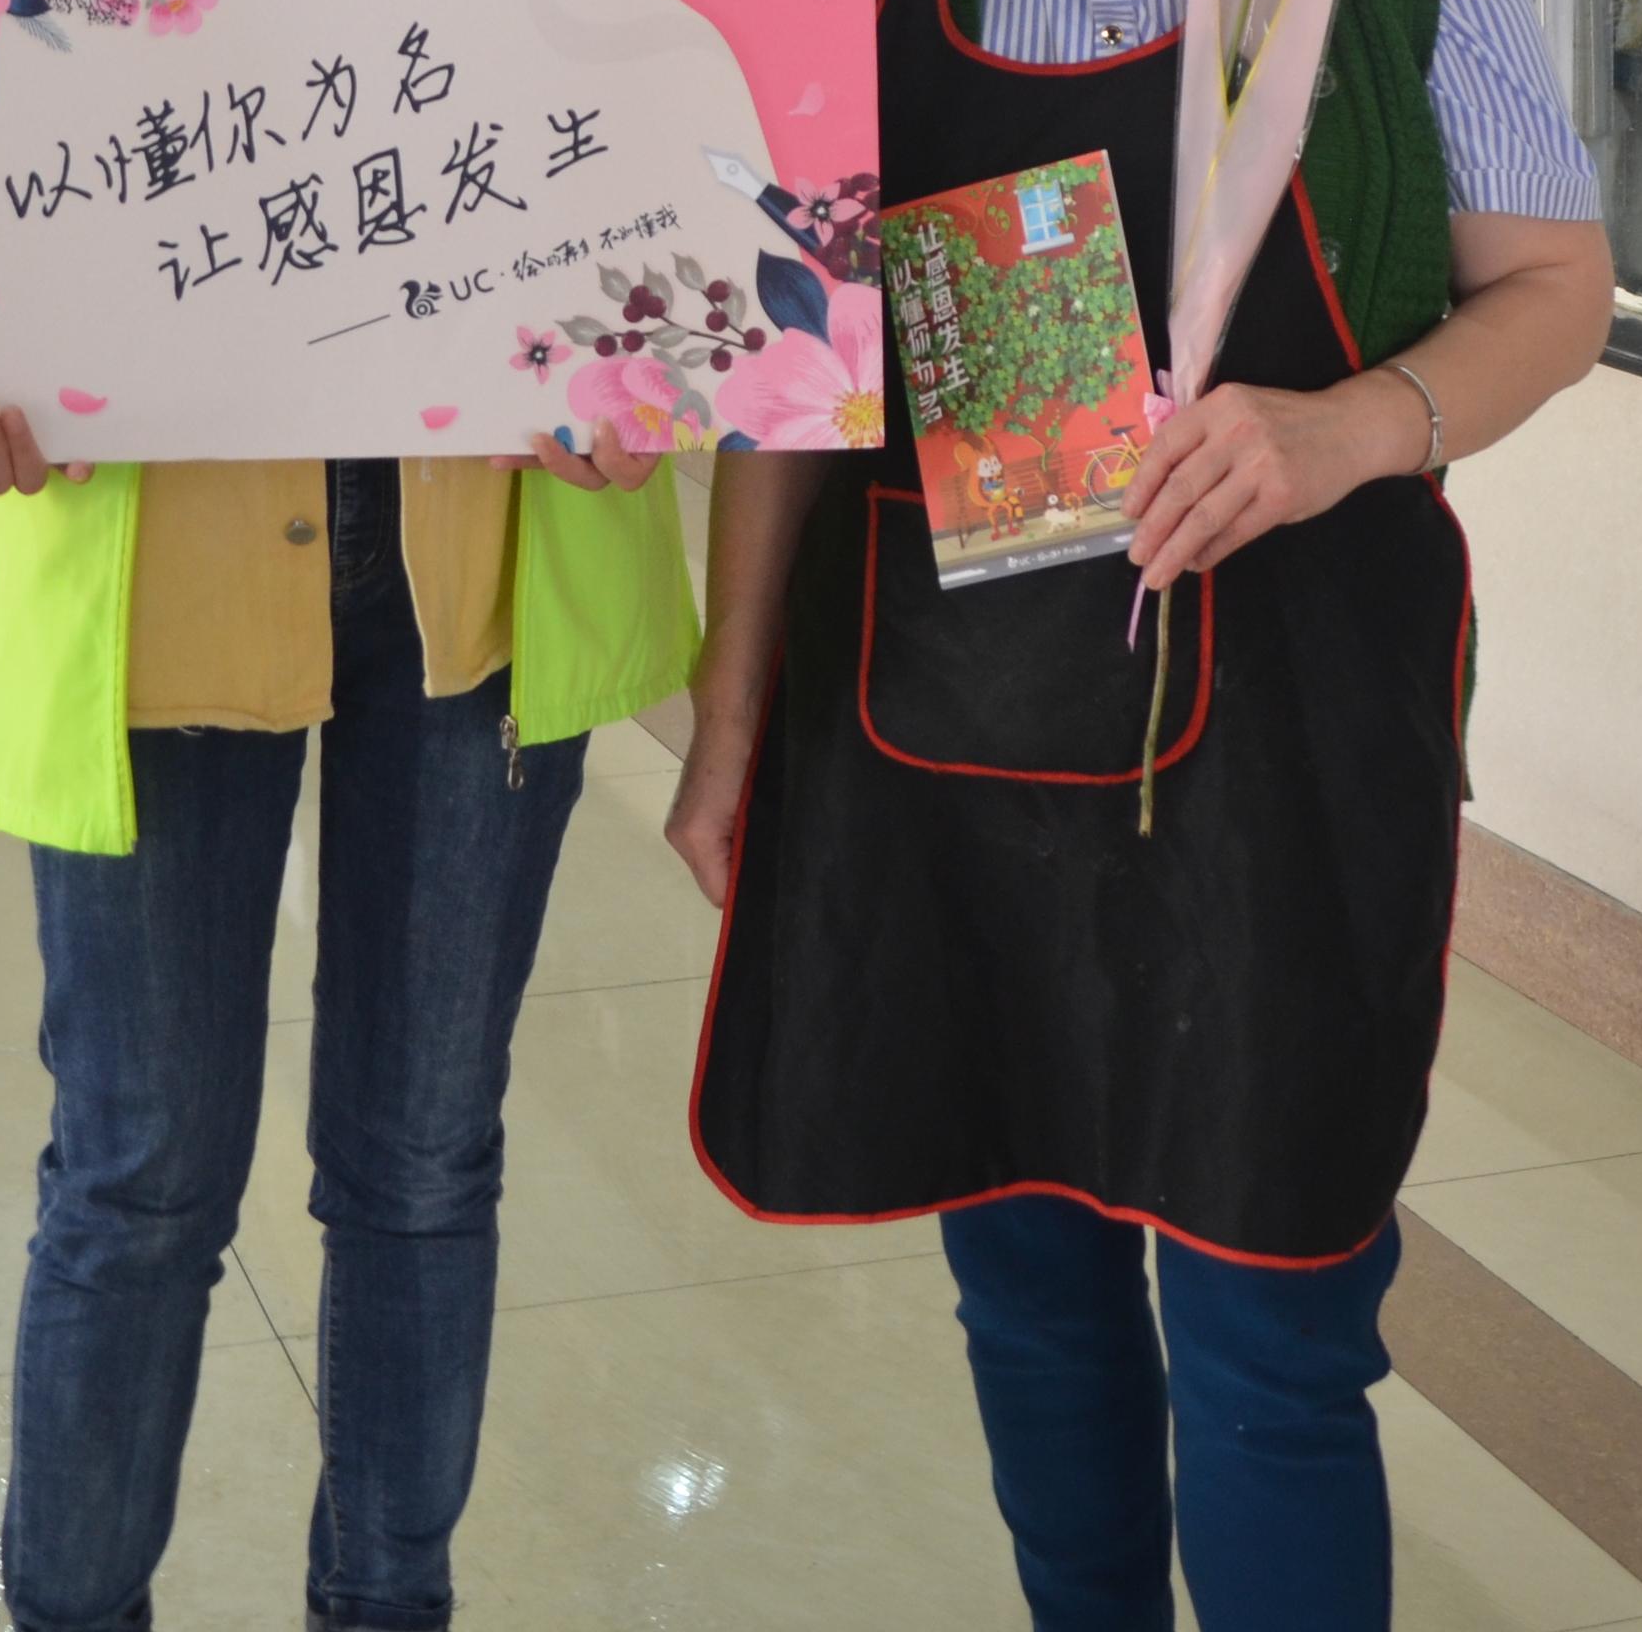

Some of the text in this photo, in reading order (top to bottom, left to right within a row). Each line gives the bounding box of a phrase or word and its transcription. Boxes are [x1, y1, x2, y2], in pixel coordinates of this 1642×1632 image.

[5, 22, 456, 219] 以懂你为名
[158, 108, 609, 301] 让感恩发生
[449, 269, 494, 301] UC
[893, 259, 943, 425] 以懂你为名
[918, 222, 970, 391] 让感恩发生
